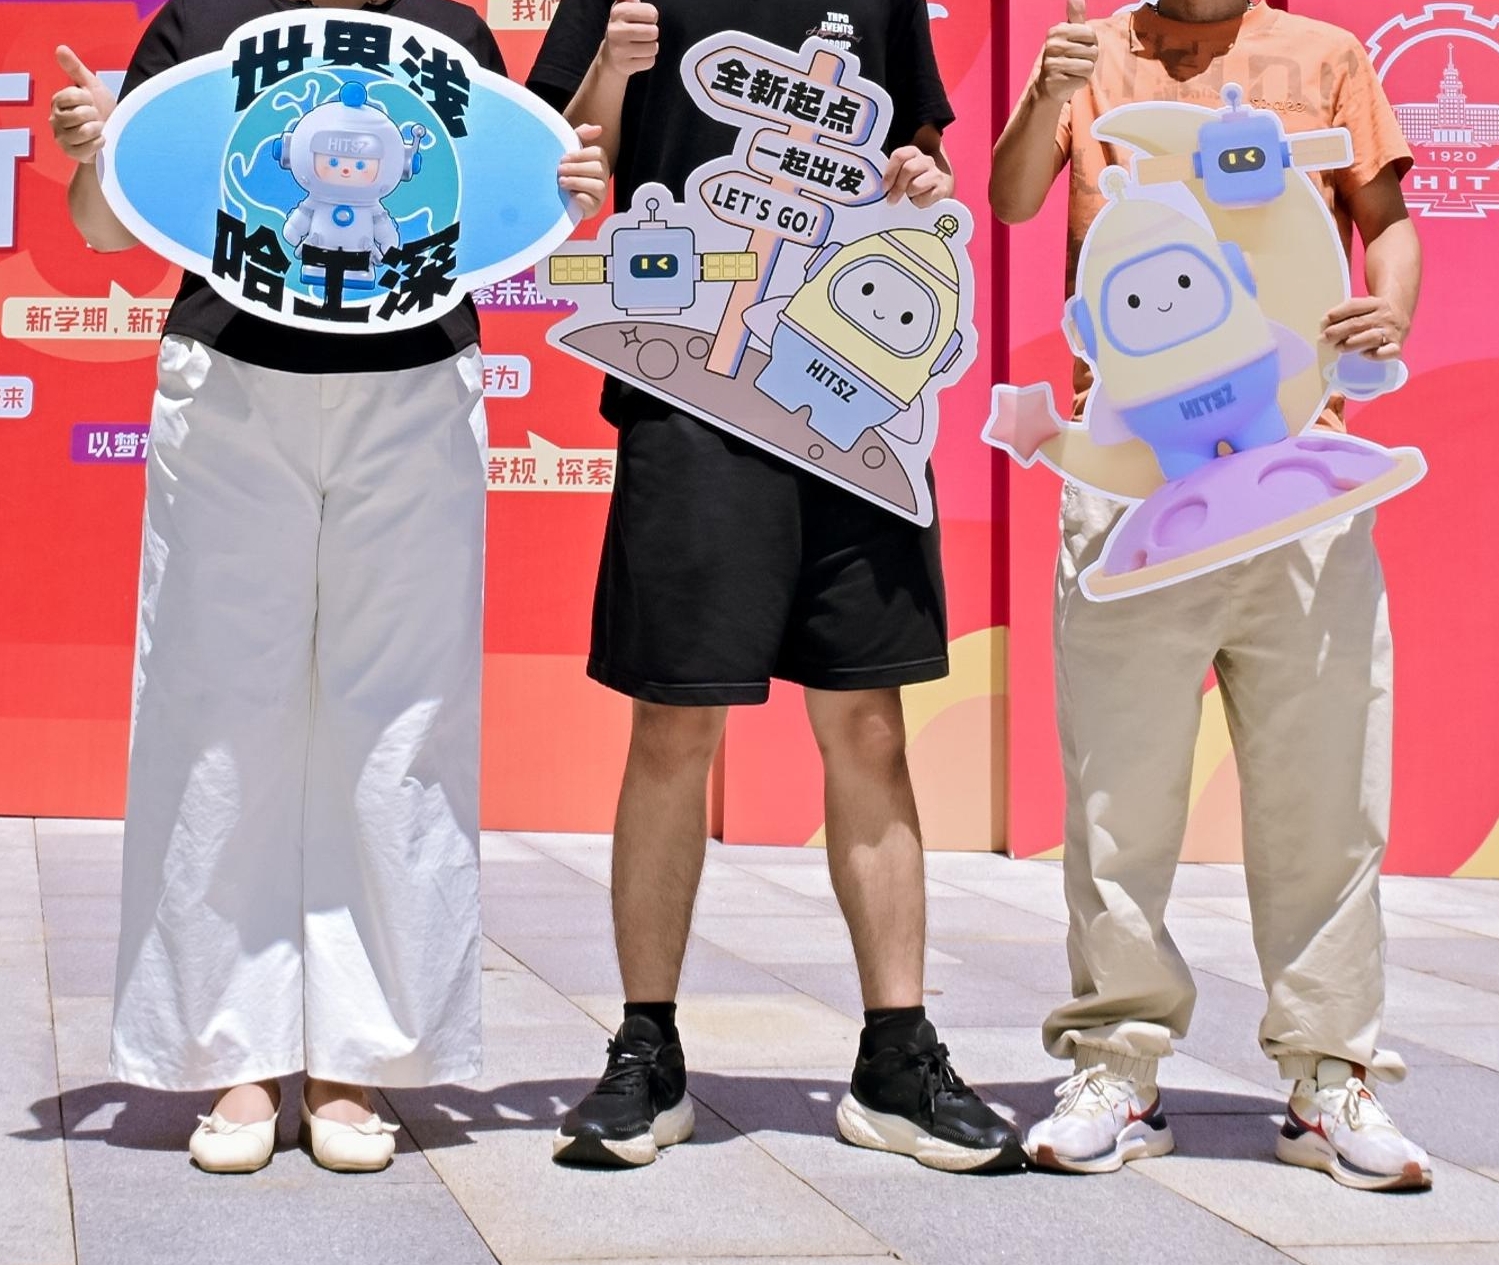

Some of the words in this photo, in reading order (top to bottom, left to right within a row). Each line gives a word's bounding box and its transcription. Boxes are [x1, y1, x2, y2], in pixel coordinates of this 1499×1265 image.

[821, 21, 854, 35] EVENTS
[230, 20, 473, 138] 世界浅
[710, 58, 862, 134] 全新起点
[755, 142, 866, 196] 一起出发
[1428, 150, 1477, 163] 1920
[1413, 175, 1490, 190] HIT
[711, 182, 774, 223] LET'S
[776, 203, 818, 238] GO!
[210, 208, 460, 325] 哈工深
[806, 357, 859, 405] HITSZ
[1177, 382, 1237, 422] HITSZ
